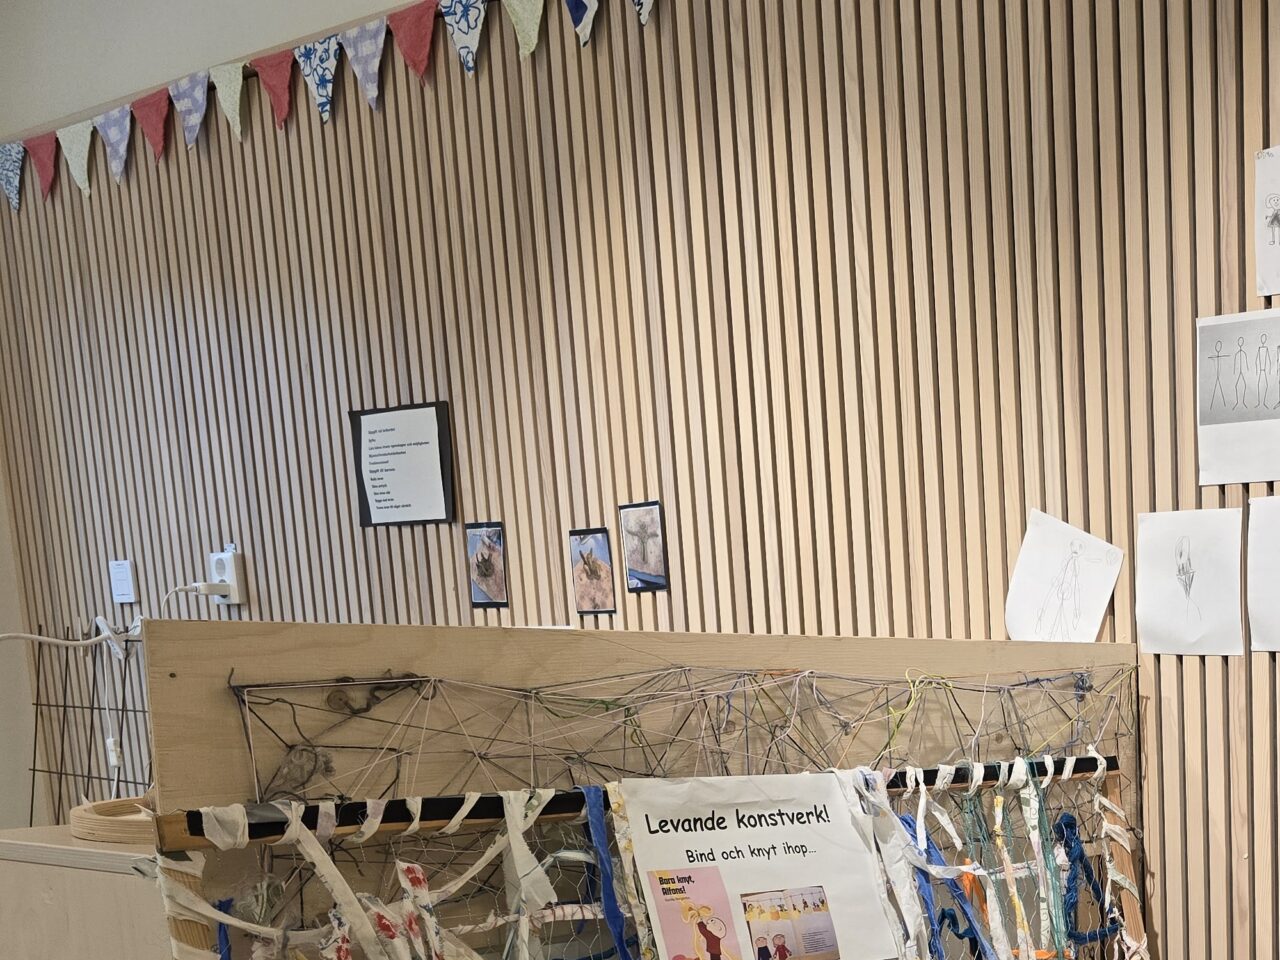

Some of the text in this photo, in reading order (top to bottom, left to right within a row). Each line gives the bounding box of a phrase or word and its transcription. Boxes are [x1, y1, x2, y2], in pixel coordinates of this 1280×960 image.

[645, 804, 831, 835] Levande konstverk!
[685, 842, 818, 863] Bind och knyt ihop...
[676, 874, 695, 884] knyt,
[661, 885, 687, 896] Alfons!
